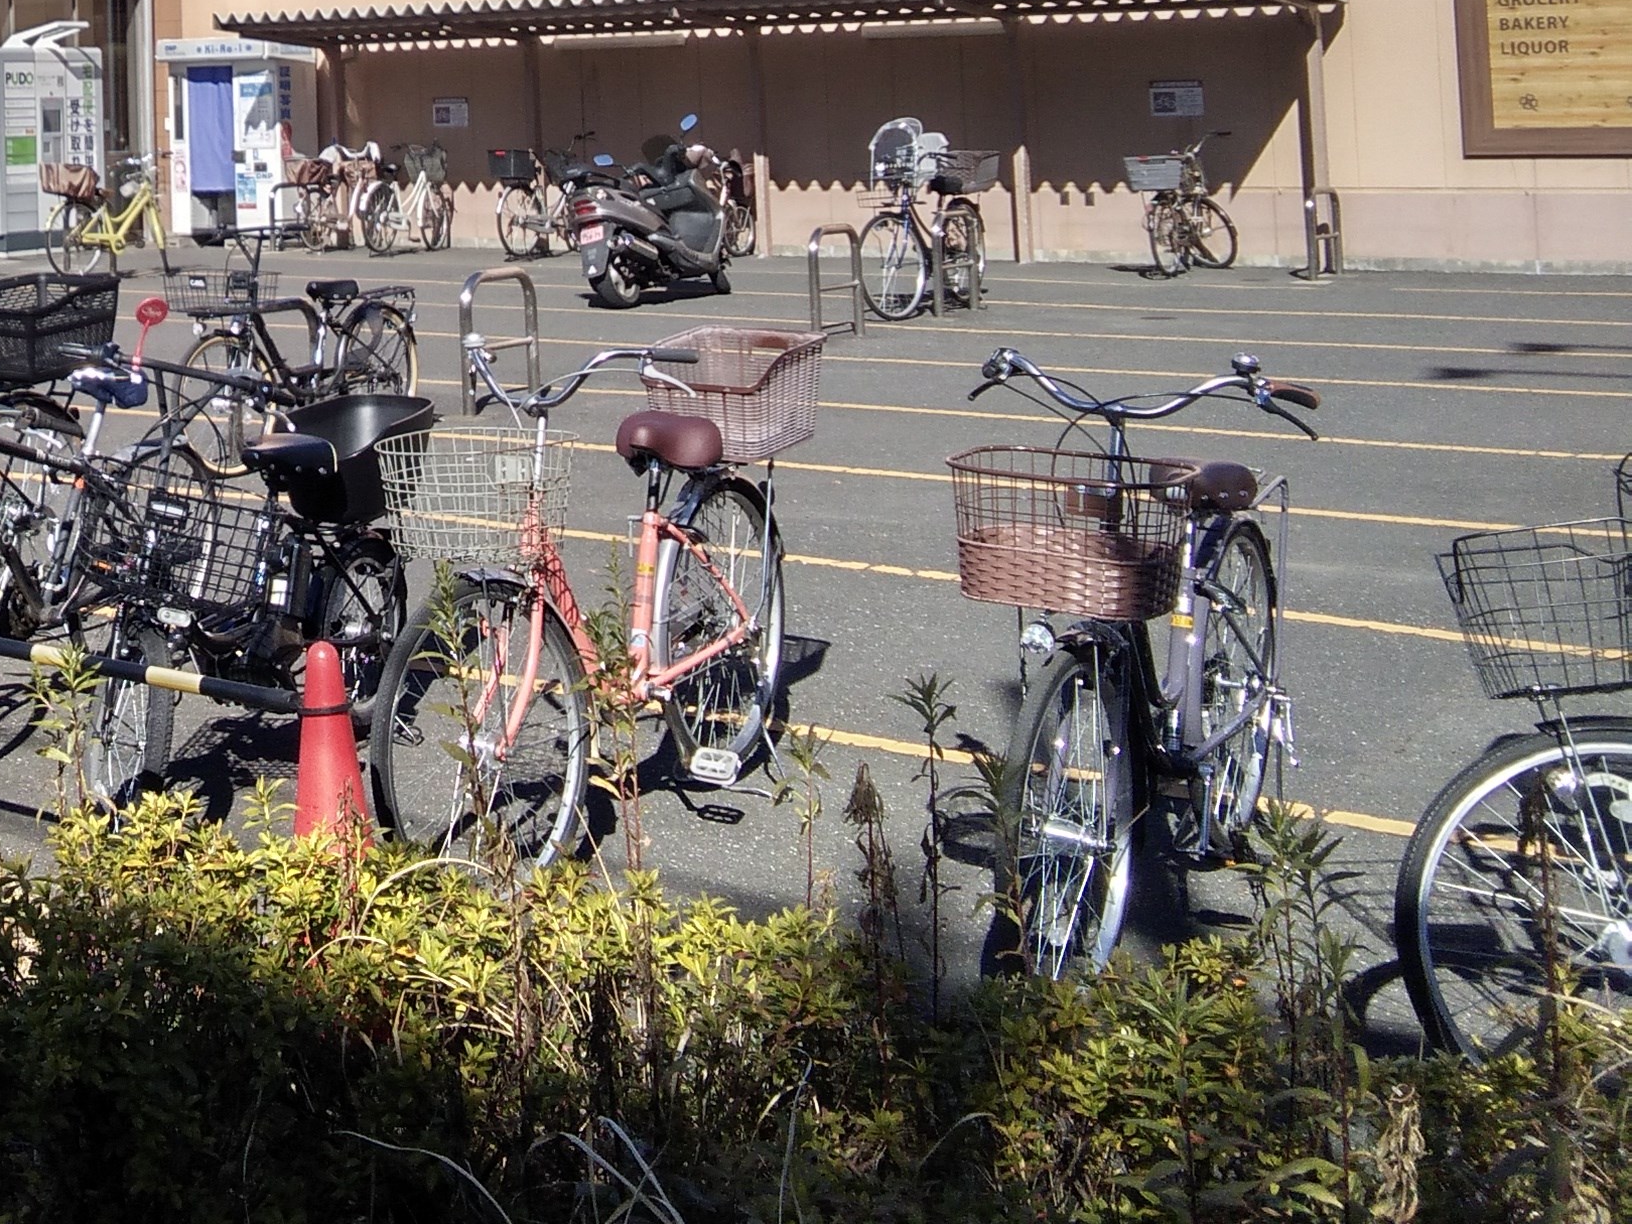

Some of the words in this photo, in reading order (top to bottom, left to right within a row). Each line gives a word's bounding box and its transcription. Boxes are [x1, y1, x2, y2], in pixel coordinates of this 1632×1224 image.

[1499, 15, 1569, 31] BAKERY
[1500, 40, 1569, 56] LIQUOR
[5, 72, 34, 85] PUDO
